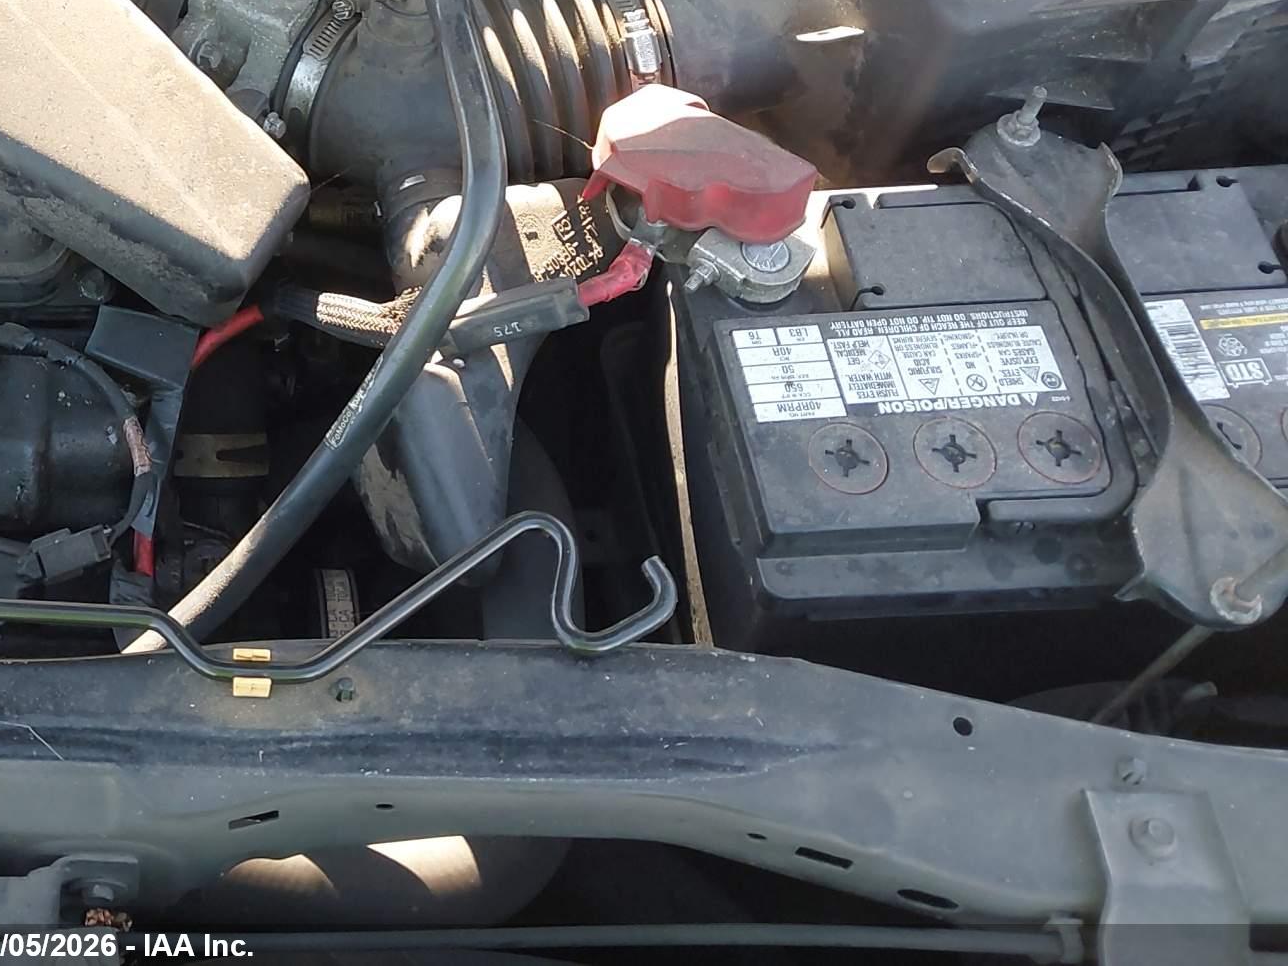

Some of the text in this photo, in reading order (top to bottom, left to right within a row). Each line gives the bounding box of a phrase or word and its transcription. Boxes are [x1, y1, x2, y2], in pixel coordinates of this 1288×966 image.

[866, 318, 887, 326] OPEN
[889, 317, 905, 325] NOT
[907, 316, 919, 324] DO
[920, 324, 930, 332] OF
[932, 322, 959, 331] REACH
[960, 321, 976, 329] THE
[748, 331, 762, 340] T6
[789, 328, 808, 337] LB3
[836, 329, 850, 337] ALL
[852, 328, 873, 336] READ
[852, 340, 870, 348] HELP
[772, 347, 792, 356] 40R
[835, 349, 867, 358] MEDICAL
[1012, 348, 1036, 356] GASES
[847, 357, 860, 365] GET
[913, 358, 930, 366] ACID
[1000, 356, 1039, 365] EXPLOSIVE
[908, 366, 942, 375] SULFURIC
[873, 372, 892, 380] WITH
[848, 380, 896, 391] IMMEDIATELY
[999, 377, 1024, 386] SHIELD
[784, 383, 803, 393] 650
[856, 389, 899, 399] FLUSH EYES
[777, 401, 821, 413] 40RPRM
[878, 393, 1022, 414] DANGER/POISON
